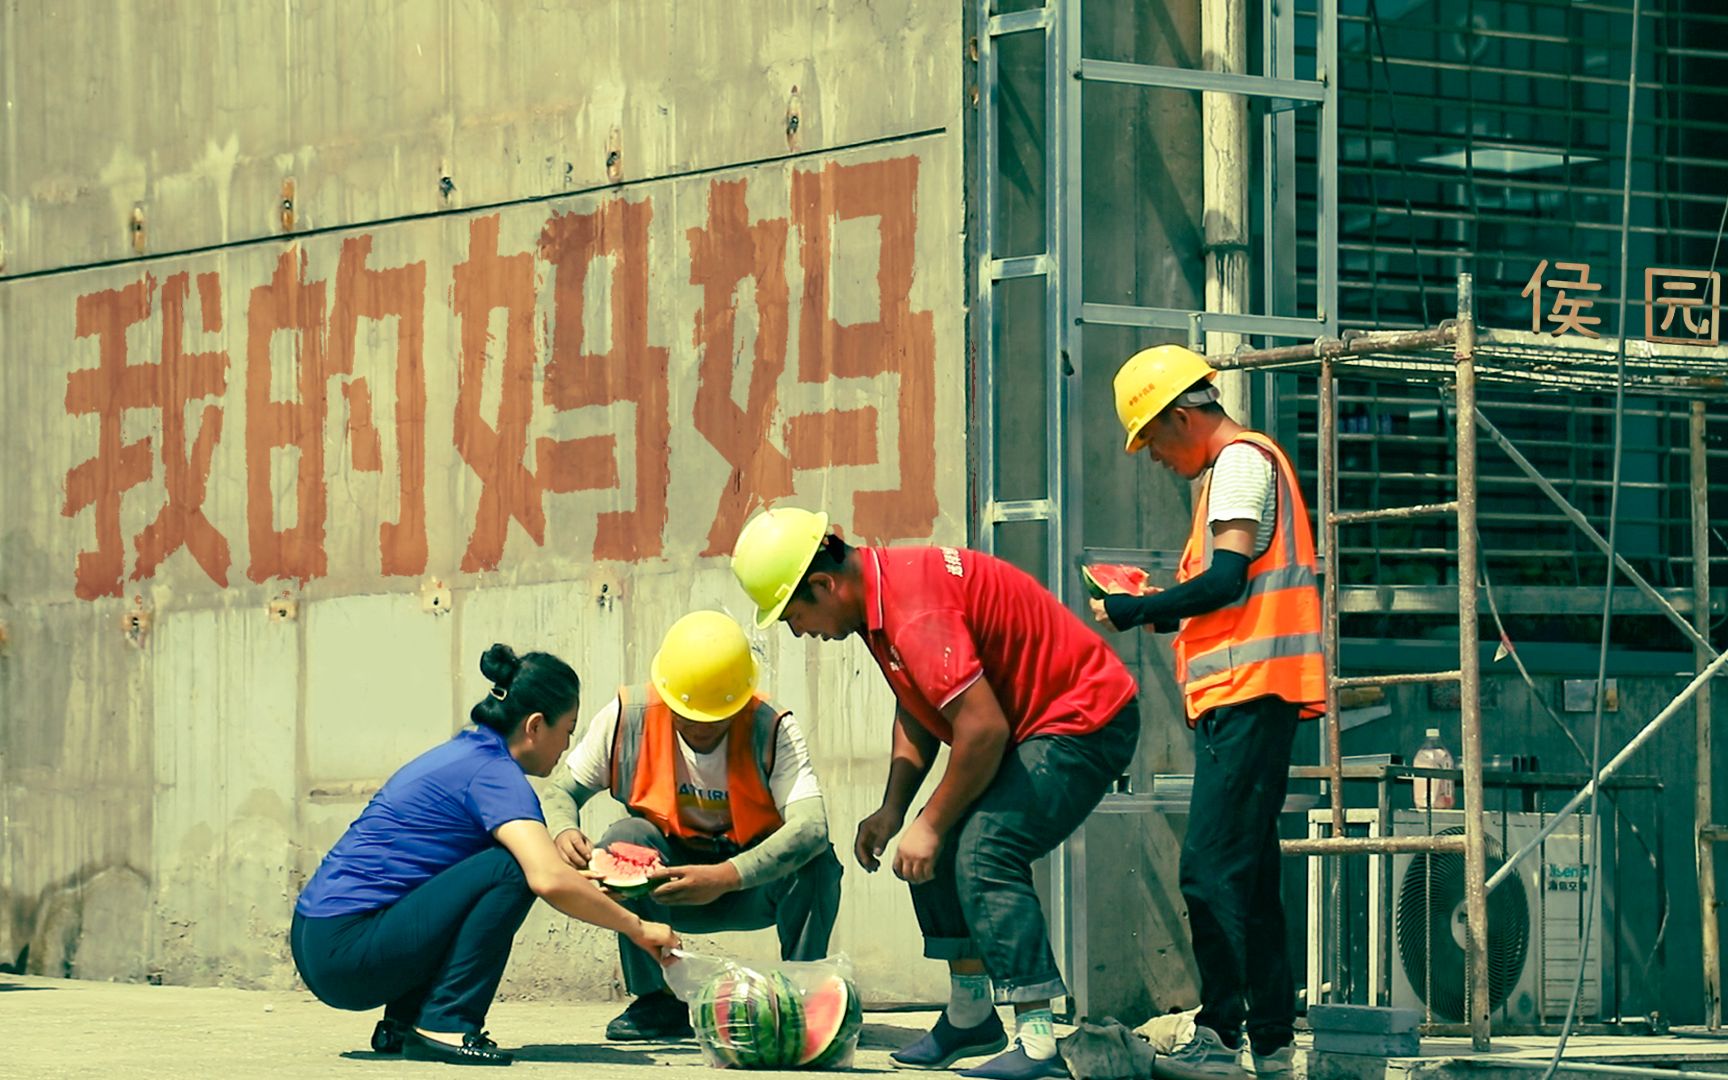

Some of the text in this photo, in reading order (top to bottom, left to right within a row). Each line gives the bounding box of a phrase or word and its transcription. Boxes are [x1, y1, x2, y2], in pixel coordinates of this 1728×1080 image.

[62, 155, 938, 600] 我的妈妈
[1521, 259, 1721, 347] 侯园
